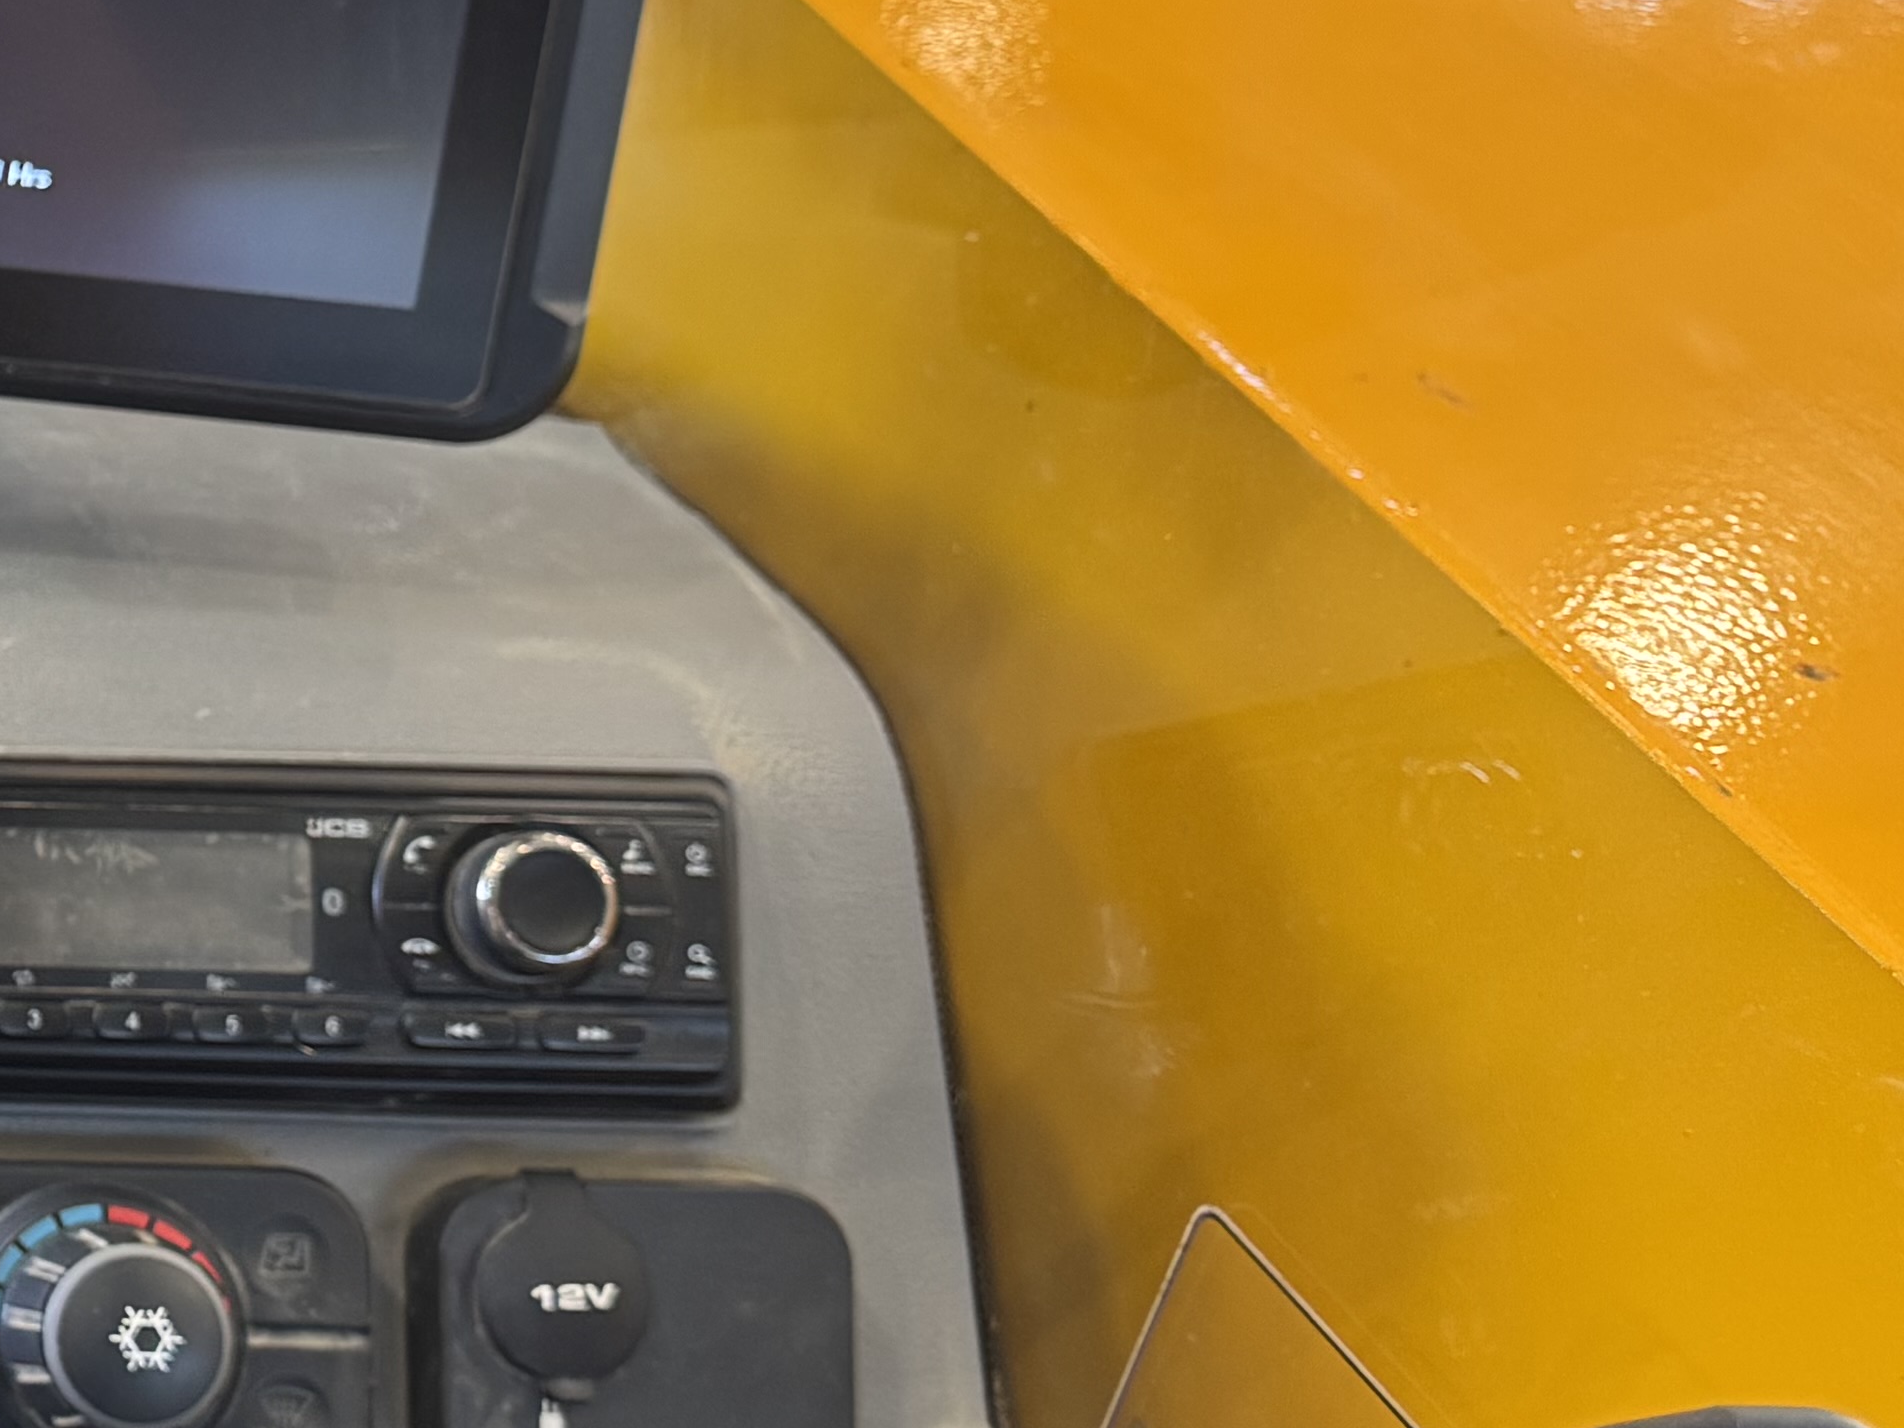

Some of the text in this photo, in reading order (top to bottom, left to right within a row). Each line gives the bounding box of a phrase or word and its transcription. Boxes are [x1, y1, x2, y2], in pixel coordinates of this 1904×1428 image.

[306, 818, 370, 839] JCB
[27, 1009, 42, 1031] 3
[124, 1011, 141, 1032] 4
[325, 1015, 341, 1038] 6
[530, 1282, 620, 1311] 12V
